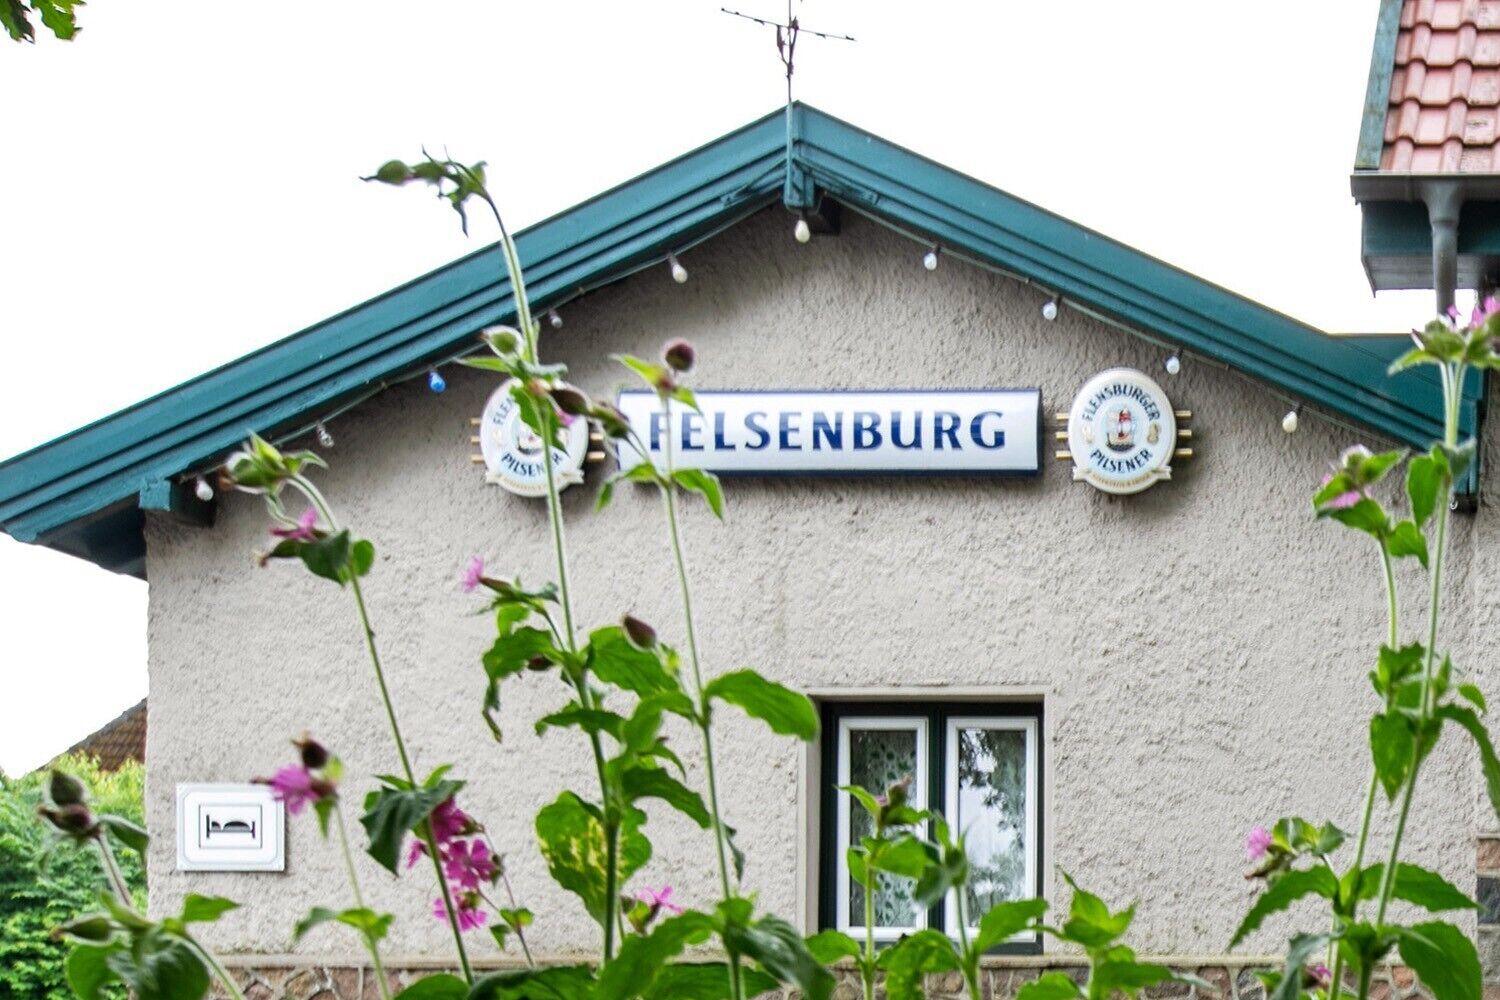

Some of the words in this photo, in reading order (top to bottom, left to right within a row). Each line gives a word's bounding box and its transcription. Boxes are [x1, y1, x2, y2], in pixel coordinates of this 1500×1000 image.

[1081, 382, 1161, 422] FLENSBURGER
[650, 411, 1006, 451] FELSENBURG
[501, 451, 563, 477] PILSENR
[1090, 448, 1153, 473] PILSENER
